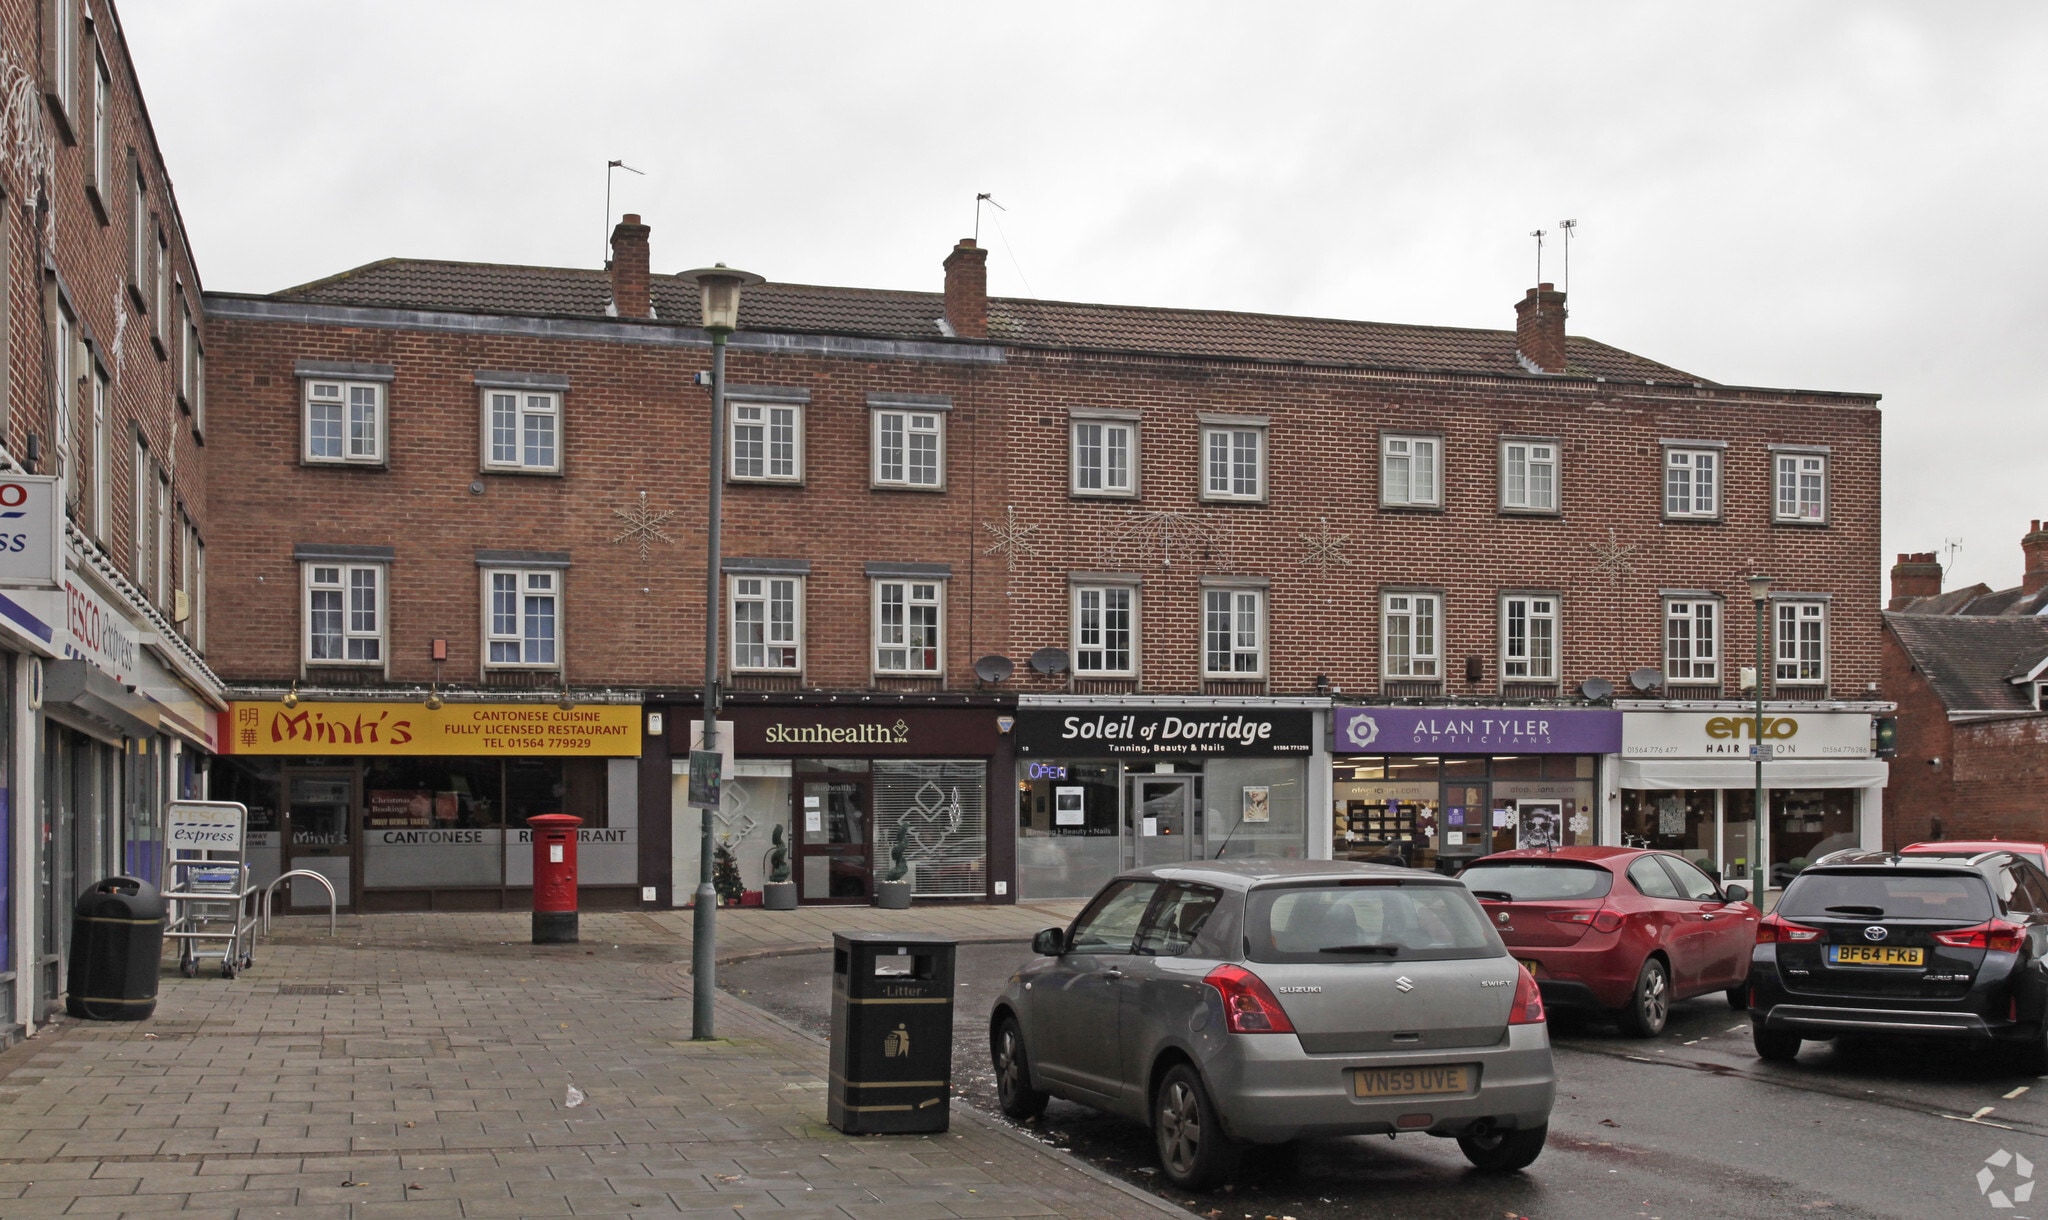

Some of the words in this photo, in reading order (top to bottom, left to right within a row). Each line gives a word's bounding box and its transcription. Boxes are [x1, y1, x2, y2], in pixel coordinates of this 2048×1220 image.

[65, 579, 100, 653] TESCO
[102, 612, 133, 672] express
[473, 711, 549, 722] CANTONESE
[552, 711, 601, 722] CUISINE
[239, 708, 259, 747] 明華
[271, 710, 413, 745] Minh's
[444, 724, 482, 735] FULLY
[485, 725, 544, 736] LICENSED
[547, 725, 629, 736] RESTAURANT
[766, 723, 893, 744] skinhealth
[1062, 715, 1135, 739] Soleil
[1140, 722, 1158, 741] of
[1161, 715, 1272, 746] Dorridge
[1413, 720, 1474, 735] ALAN
[1481, 720, 1550, 736] TYLER
[1705, 716, 1799, 740] enzo
[483, 738, 505, 749] TEL
[508, 738, 545, 749] 01564
[548, 738, 592, 749] 779929
[893, 736, 908, 744] SPA
[1413, 735, 1552, 744] OPTICIANS
[1108, 743, 1150, 754] Tanning,
[1153, 743, 1188, 753] Beauty
[1190, 743, 1198, 752] &
[1200, 743, 1225, 752] Nails
[1627, 746, 1648, 754] 01564
[1649, 746, 1663, 754] 776
[1665, 746, 1679, 754] 477
[1706, 744, 1740, 753] HAIR
[1822, 746, 1842, 754] 01564
[1842, 746, 1868, 754] 776286
[174, 809, 237, 823] TESCO
[174, 828, 234, 843] express
[292, 830, 348, 845] Minh's
[383, 830, 483, 844] CANTONESE
[1062, 828, 1088, 836] Beauty
[1093, 827, 1111, 835] Nails
[1840, 946, 1882, 961] BF64
[1886, 948, 1919, 963] FKB
[1279, 985, 1322, 994] SUZUKI
[1480, 979, 1513, 988] SWIFT
[887, 985, 923, 997] Litter
[1363, 1071, 1415, 1093] VN59
[1422, 1069, 1460, 1090] UVE
